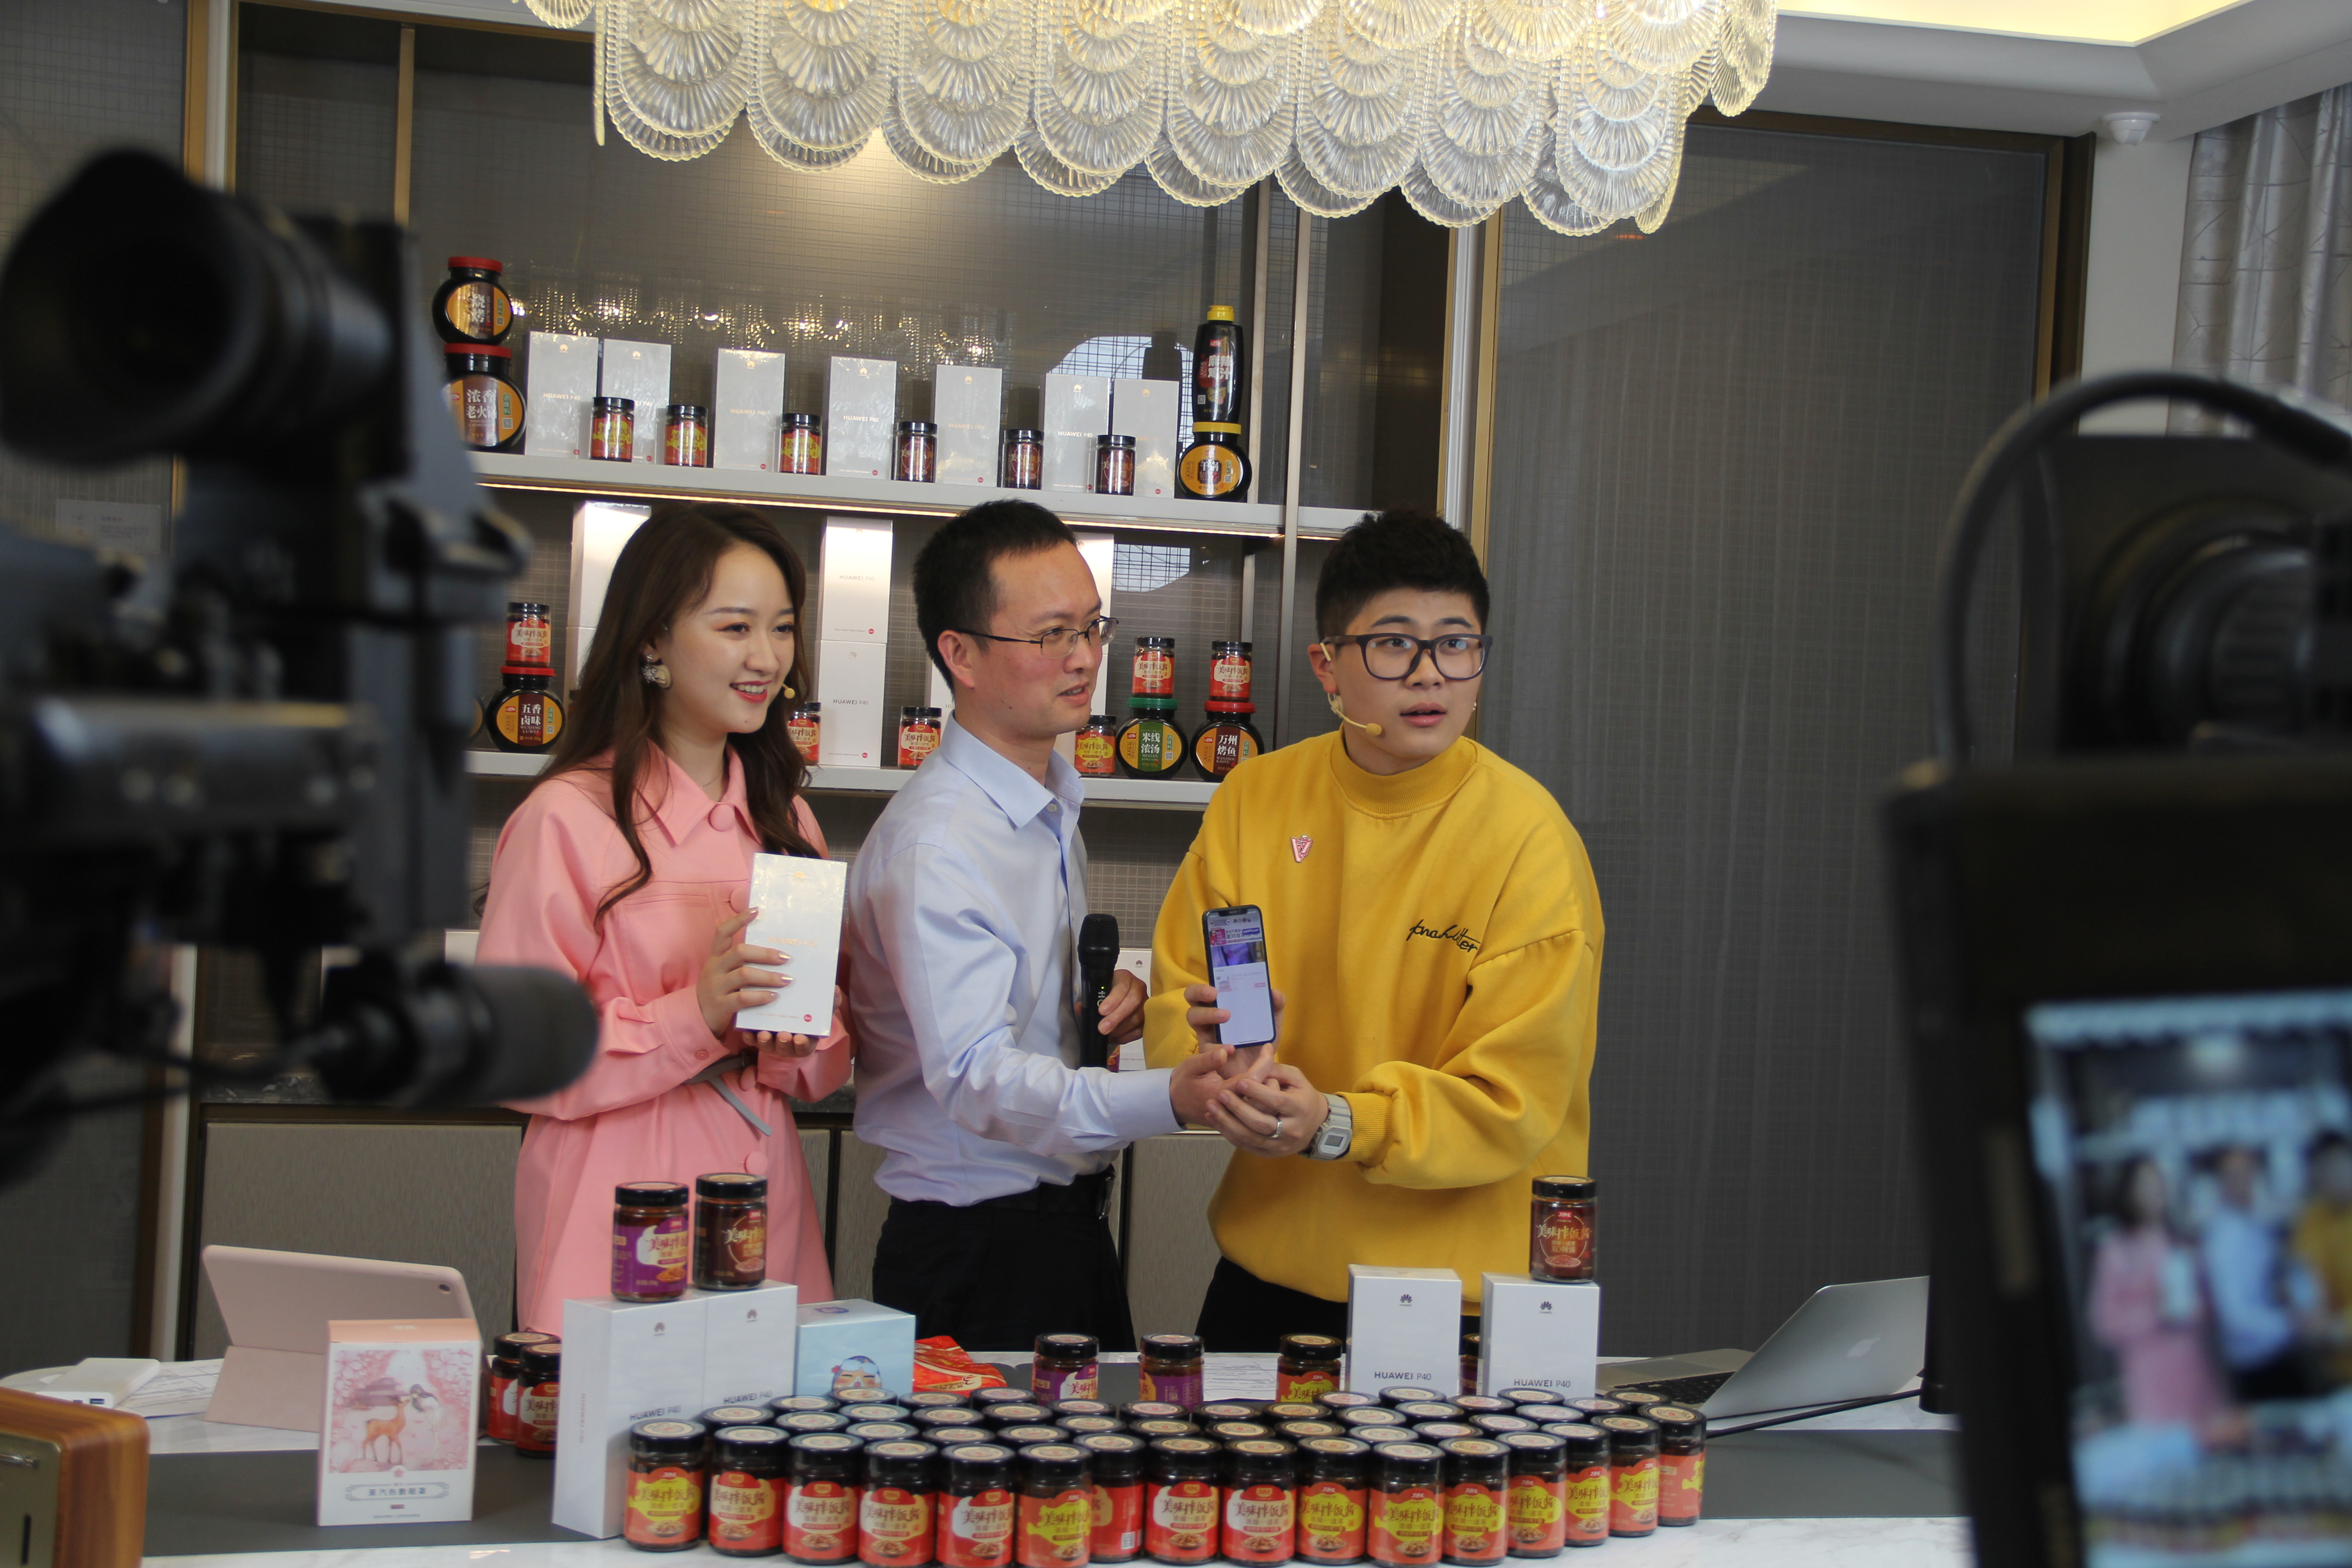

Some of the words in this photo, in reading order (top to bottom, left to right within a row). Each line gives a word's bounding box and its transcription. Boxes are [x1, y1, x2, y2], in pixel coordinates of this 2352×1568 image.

[522, 704, 541, 714] 五香
[521, 715, 541, 725] 卤味
[904, 733, 936, 742] 美味拌饭酱
[1142, 732, 1160, 743] 米线
[1218, 735, 1238, 745] 万州
[1141, 743, 1160, 754] 浓汤
[1217, 745, 1236, 757] 烤鱼
[1535, 1223, 1592, 1240] 美味拌饭酱
[1374, 1371, 1413, 1380] HUAWEI
[1416, 1372, 1431, 1381] P40
[1514, 1378, 1553, 1387] HUAWEI
[1556, 1379, 1571, 1387] P40
[526, 1397, 559, 1412] 美味拌
[724, 1392, 757, 1405] HUAWEI
[760, 1390, 772, 1399] P40
[630, 1408, 665, 1421] HUAWEI
[668, 1405, 681, 1414] P40
[1566, 1485, 1609, 1501] 美味拌饭
[866, 1504, 922, 1521] 美味拌饭酱
[1159, 1498, 1218, 1515] 美味拌饭酱
[1232, 1502, 1291, 1518] 美味拌饭酱
[1301, 1499, 1359, 1518] 美味拌饭酱
[1384, 1506, 1444, 1523] 美味拌饭酱
